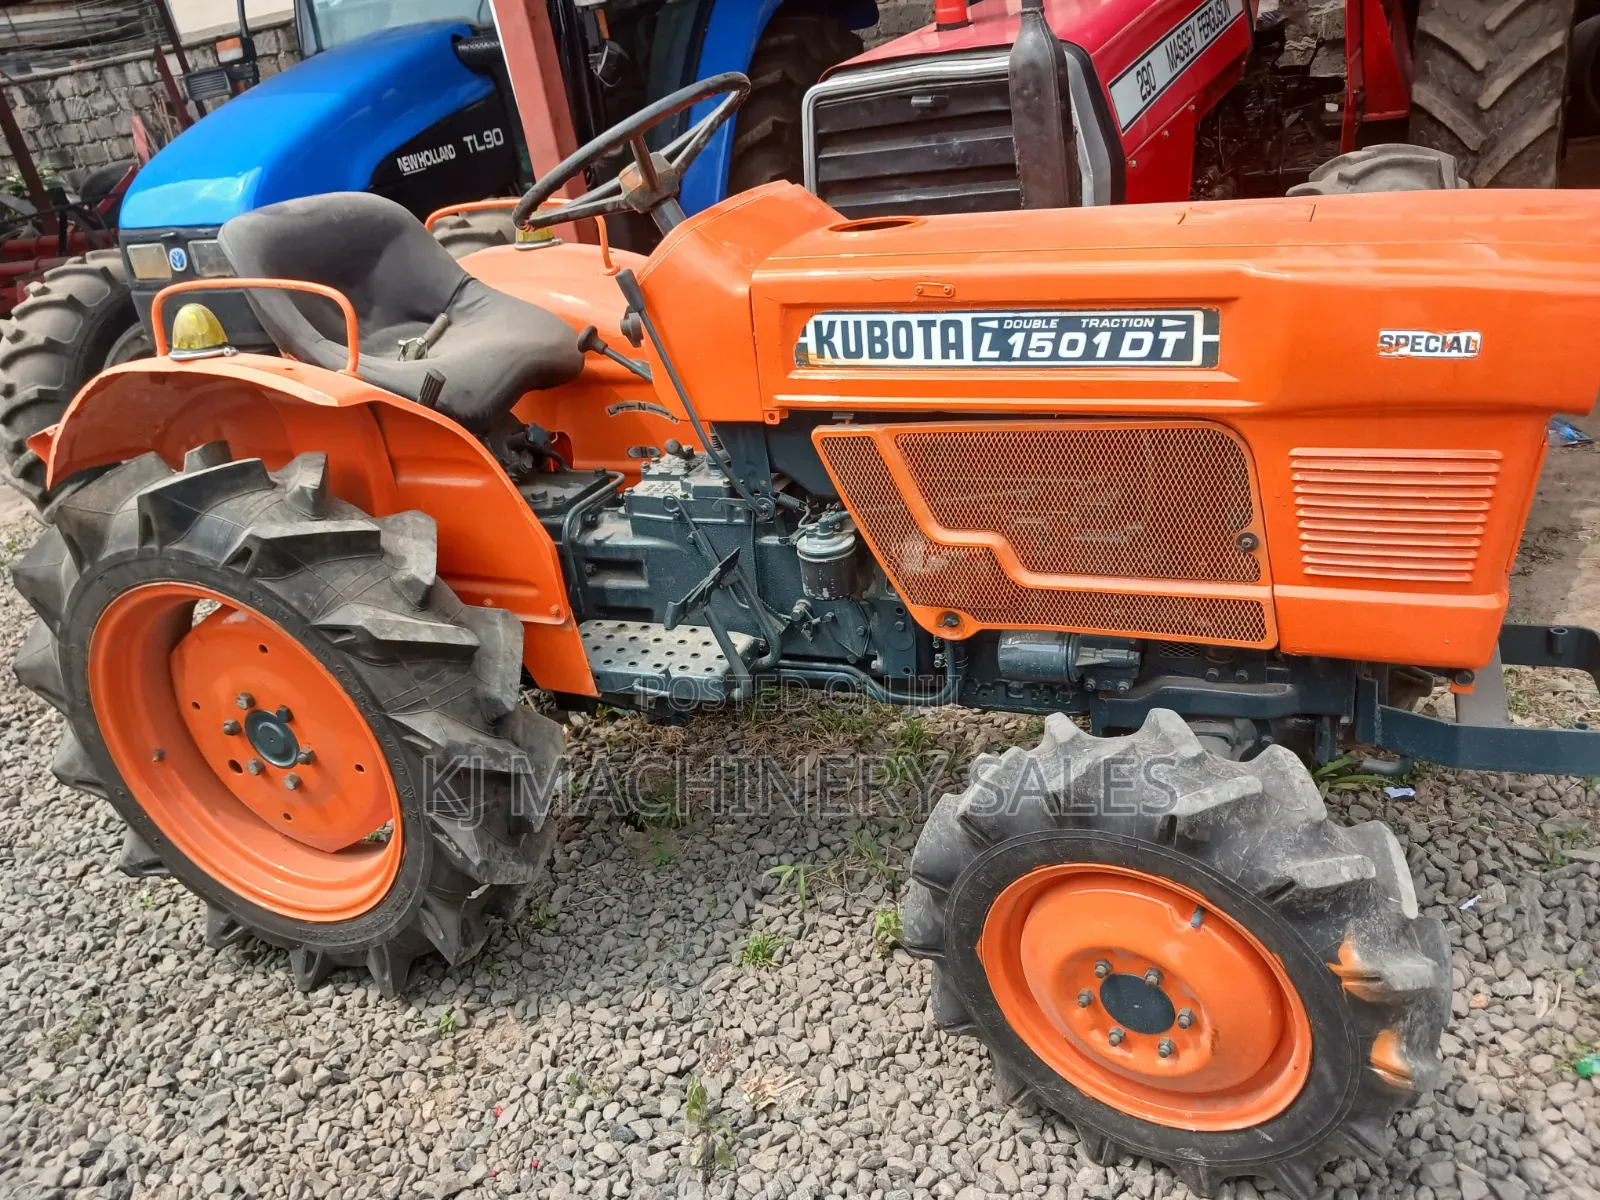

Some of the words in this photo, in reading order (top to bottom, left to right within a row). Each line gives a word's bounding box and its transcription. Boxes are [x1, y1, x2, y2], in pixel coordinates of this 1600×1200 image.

[1136, 60, 1156, 102] 290
[1165, 21, 1198, 73] MASSEY
[1197, 0, 1231, 43] FERGUSON
[463, 128, 504, 154] TL90
[1003, 319, 1060, 330] DOUBLE
[1080, 318, 1155, 329] TRACTION
[814, 319, 965, 361] KUBOTA
[1379, 334, 1479, 354] SPECIAL
[638, 403, 647, 411] N
